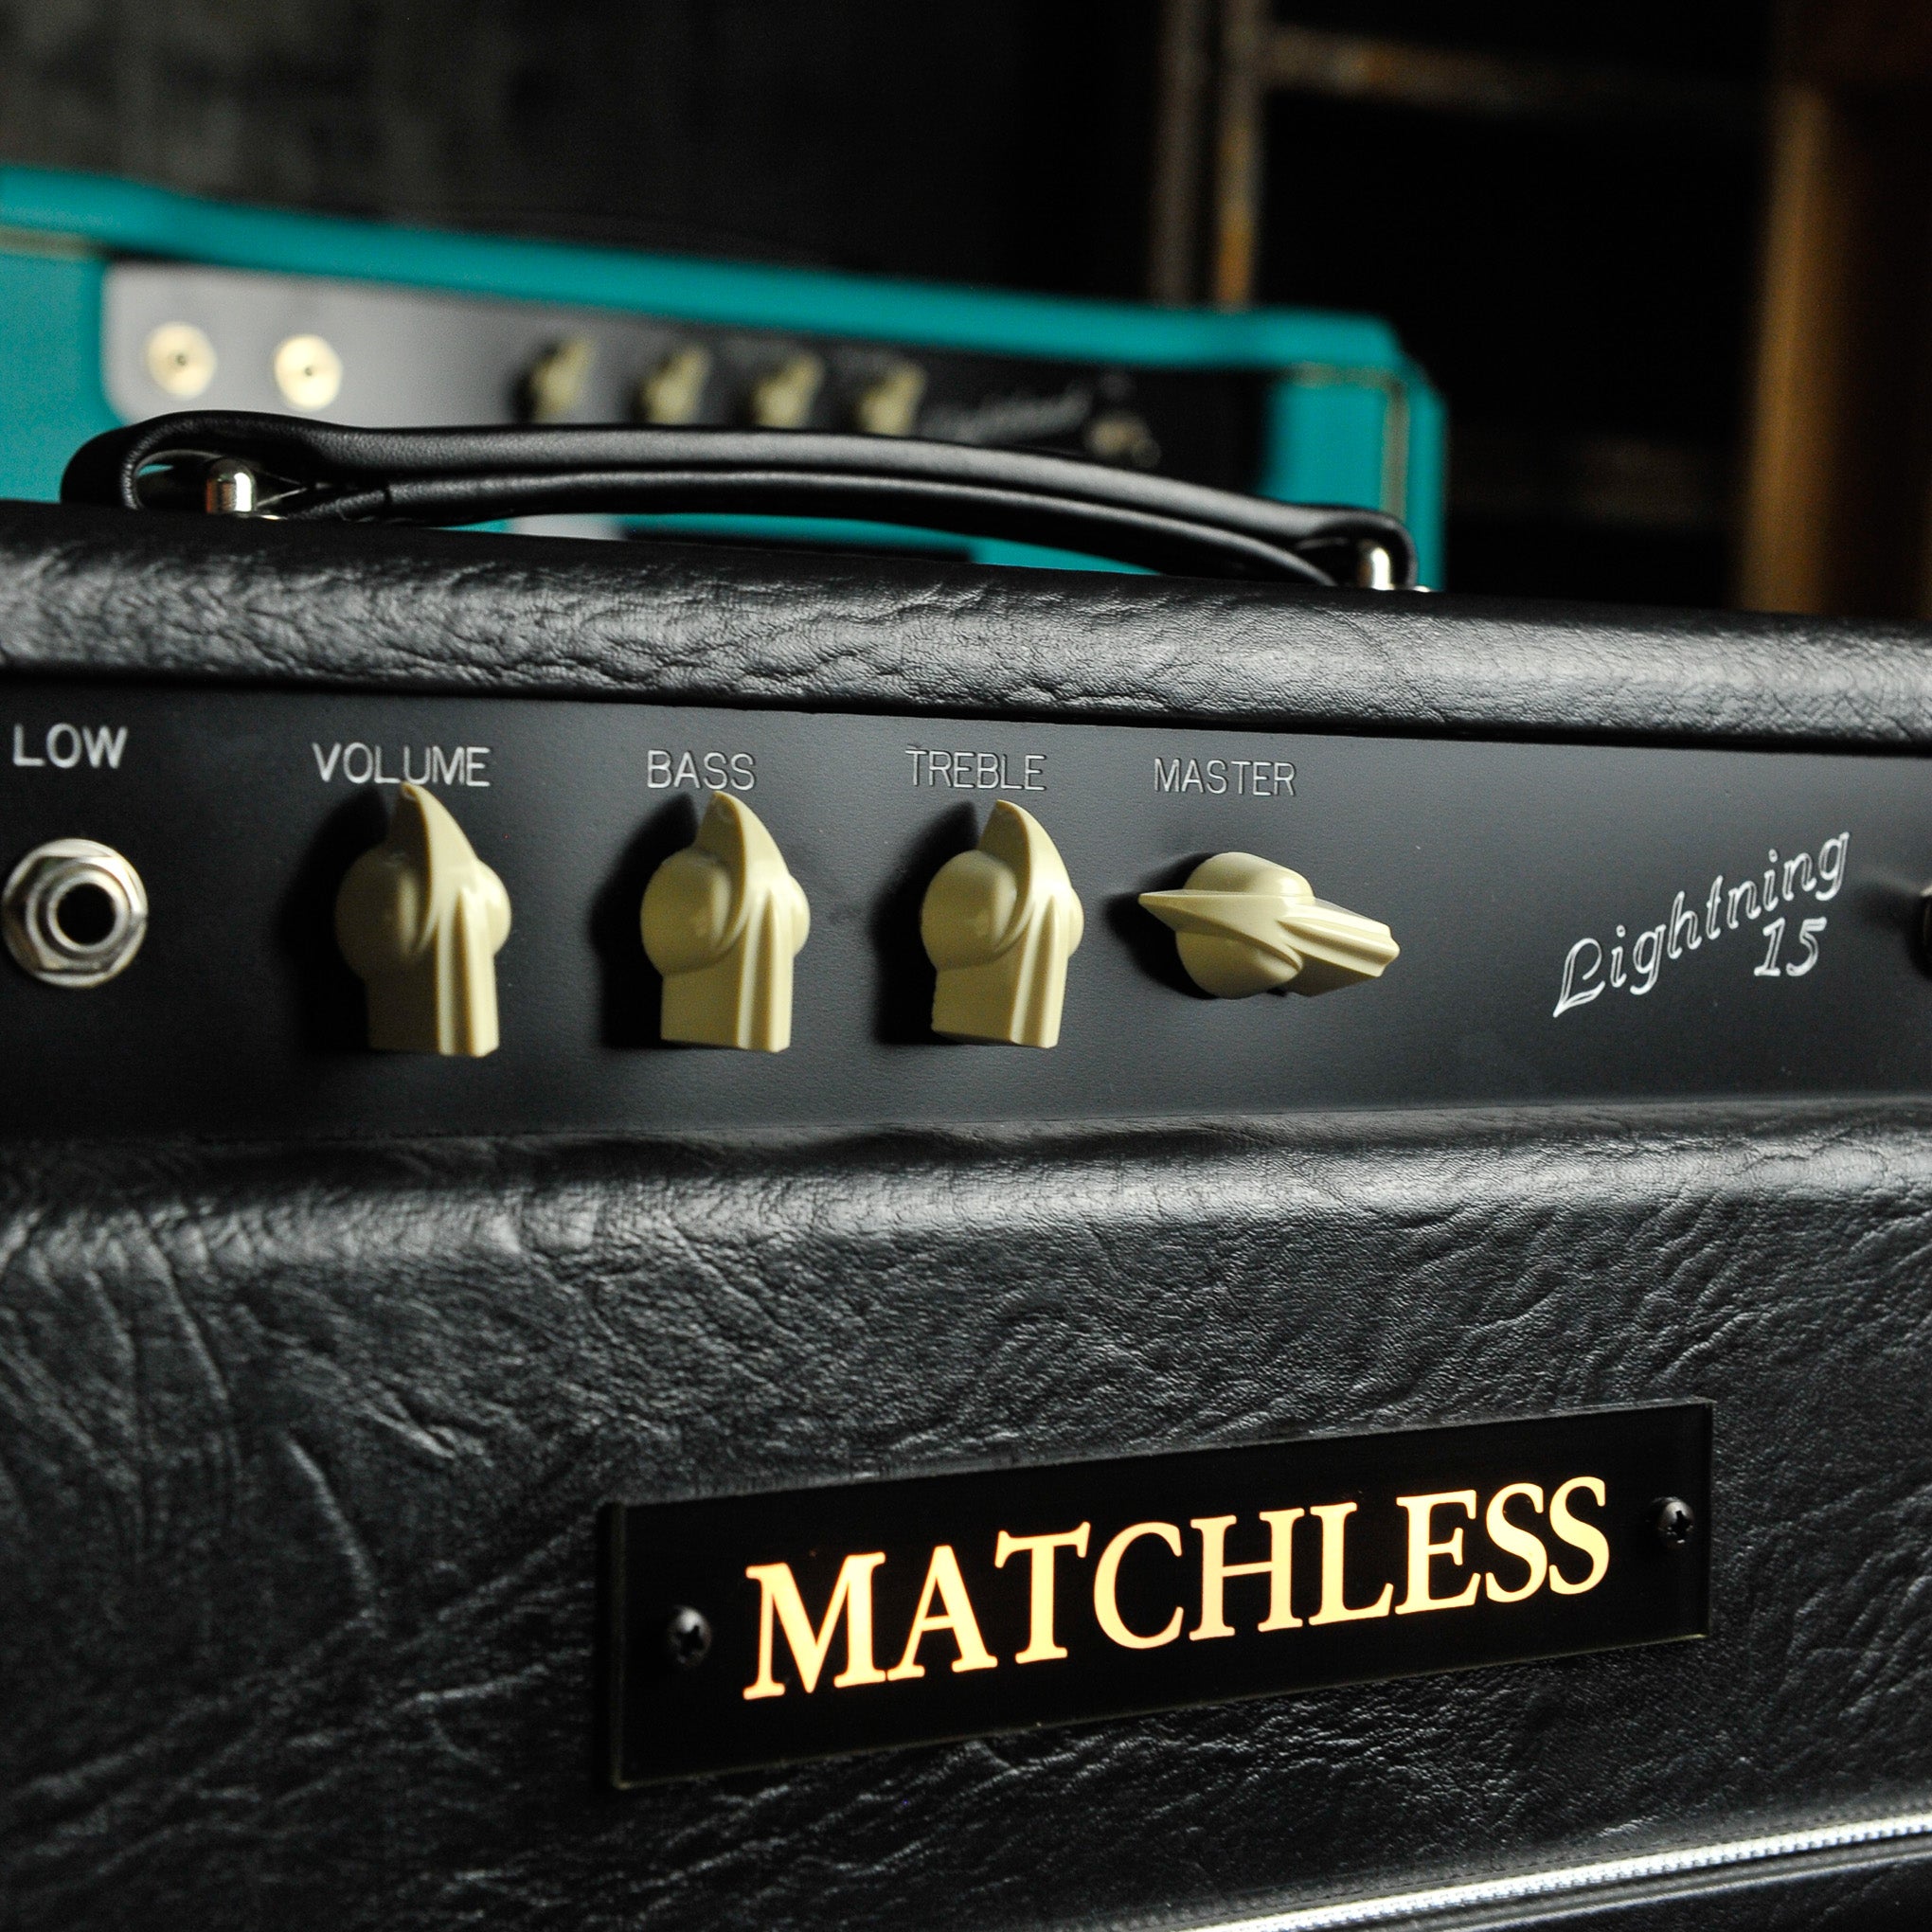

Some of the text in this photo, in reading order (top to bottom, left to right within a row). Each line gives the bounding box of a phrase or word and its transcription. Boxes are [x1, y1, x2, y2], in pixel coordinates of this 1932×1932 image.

[11, 724, 128, 769] LOW
[312, 742, 492, 788] VOLUME
[646, 747, 758, 792] BASS
[905, 746, 1047, 793] TREBLE
[1153, 757, 1297, 798] MASTER
[1551, 830, 1852, 1019] Lightning
[1752, 915, 1829, 978] 15
[742, 1475, 1612, 1702] MATCHLESS
